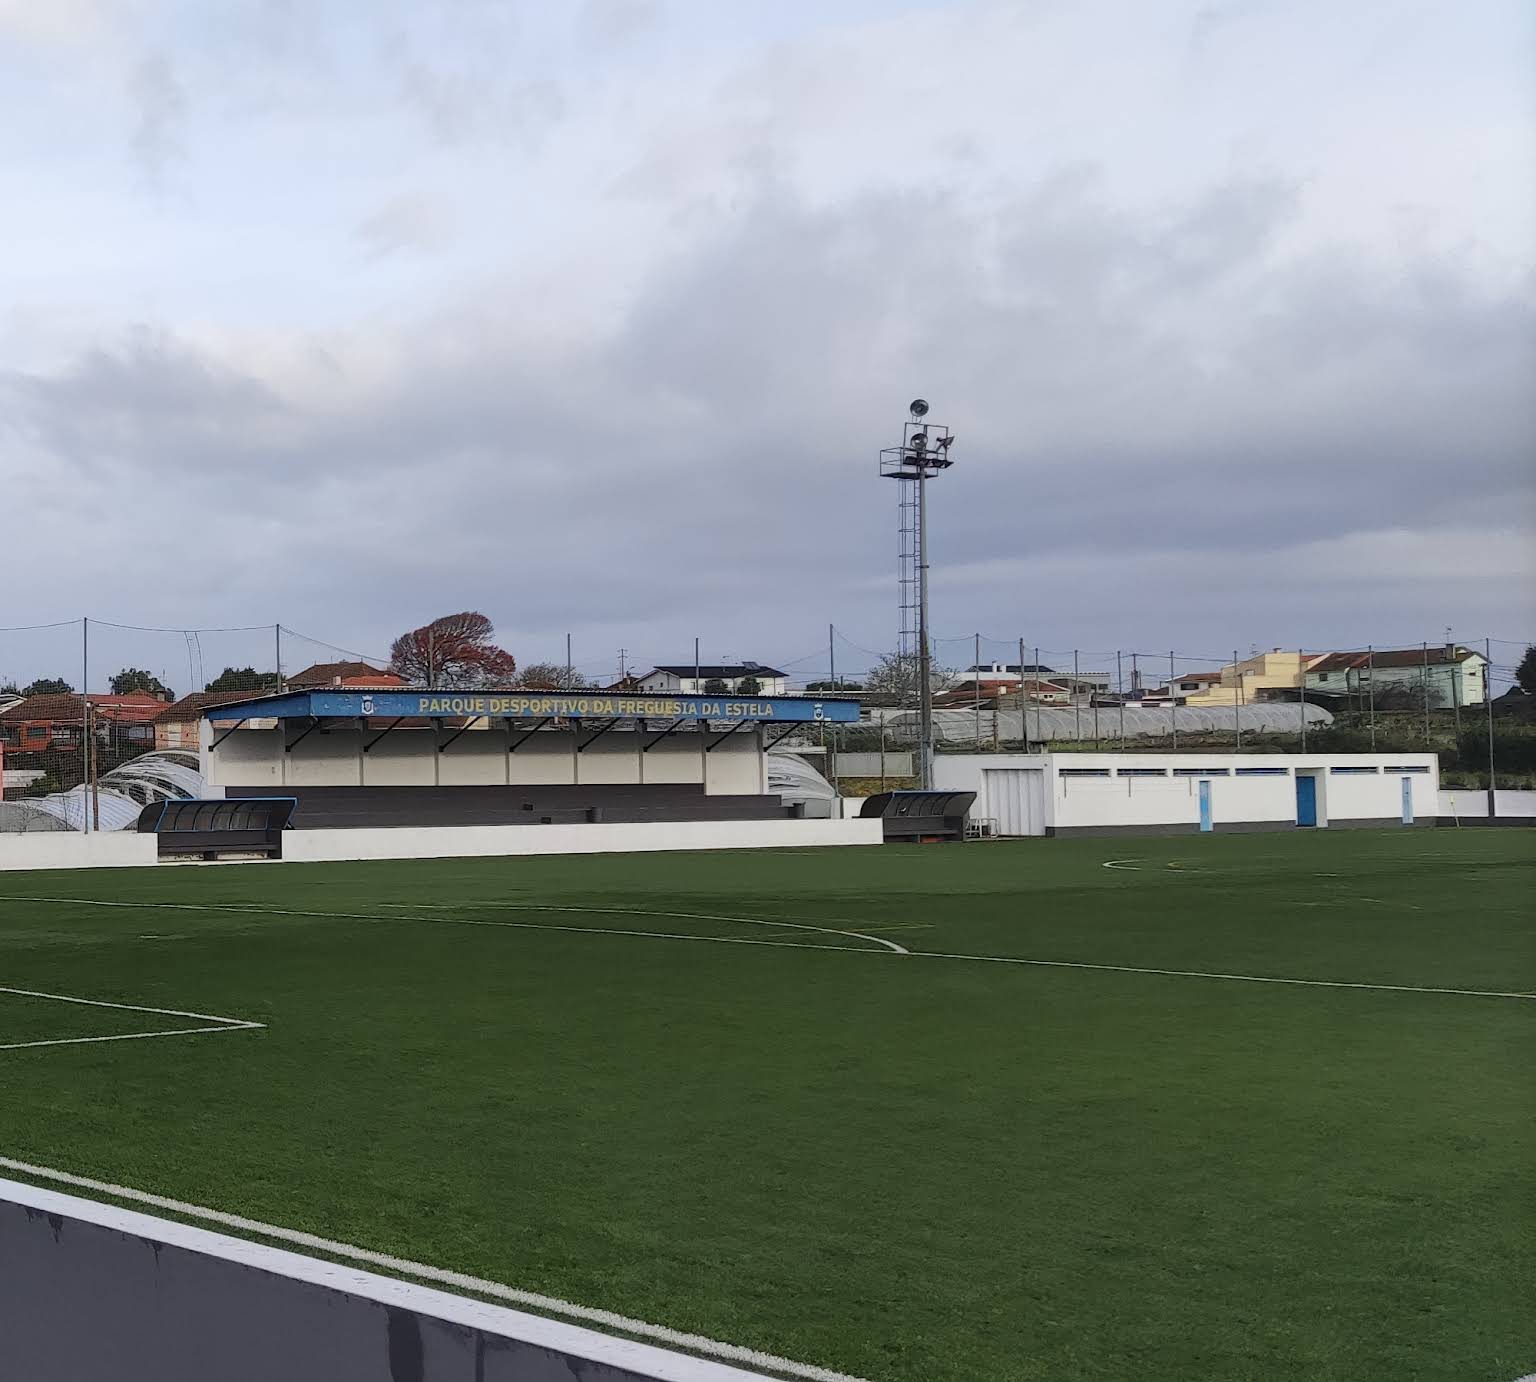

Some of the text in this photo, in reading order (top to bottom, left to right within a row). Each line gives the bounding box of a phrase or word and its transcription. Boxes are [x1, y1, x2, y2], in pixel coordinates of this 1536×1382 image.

[419, 699, 774, 716] PARQUE DESPORTIVO DA FREGUESIA DA ESTELA
